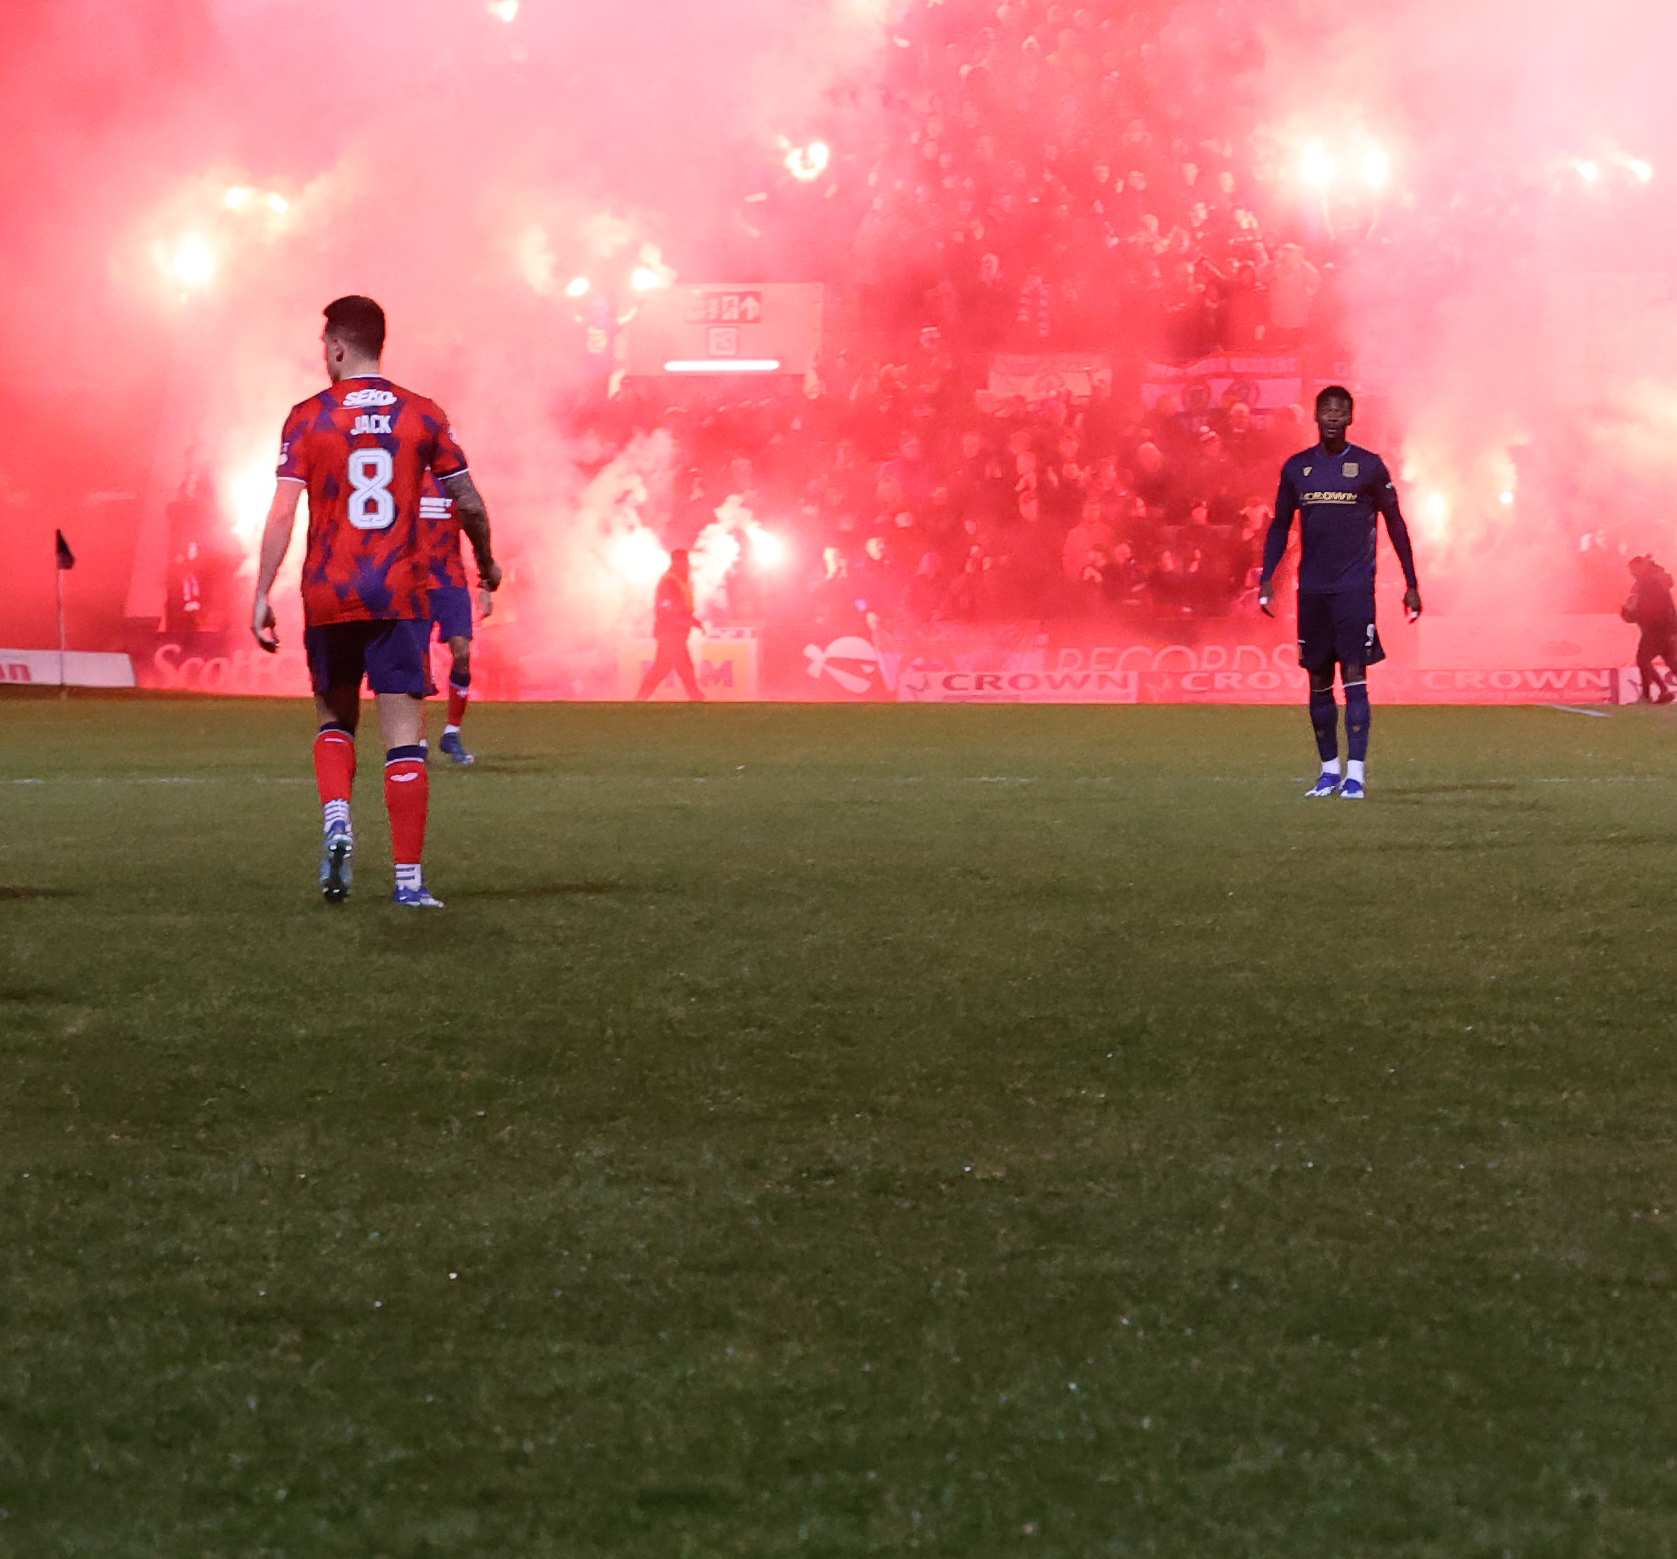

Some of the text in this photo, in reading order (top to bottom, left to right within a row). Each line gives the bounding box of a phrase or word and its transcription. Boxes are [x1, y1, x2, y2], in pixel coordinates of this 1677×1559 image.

[350, 414, 393, 435] JACK
[348, 447, 395, 529] 8
[942, 673, 1129, 691] CROWN
[1182, 672, 1304, 690] CRO
[1424, 669, 1610, 690] CROWN
